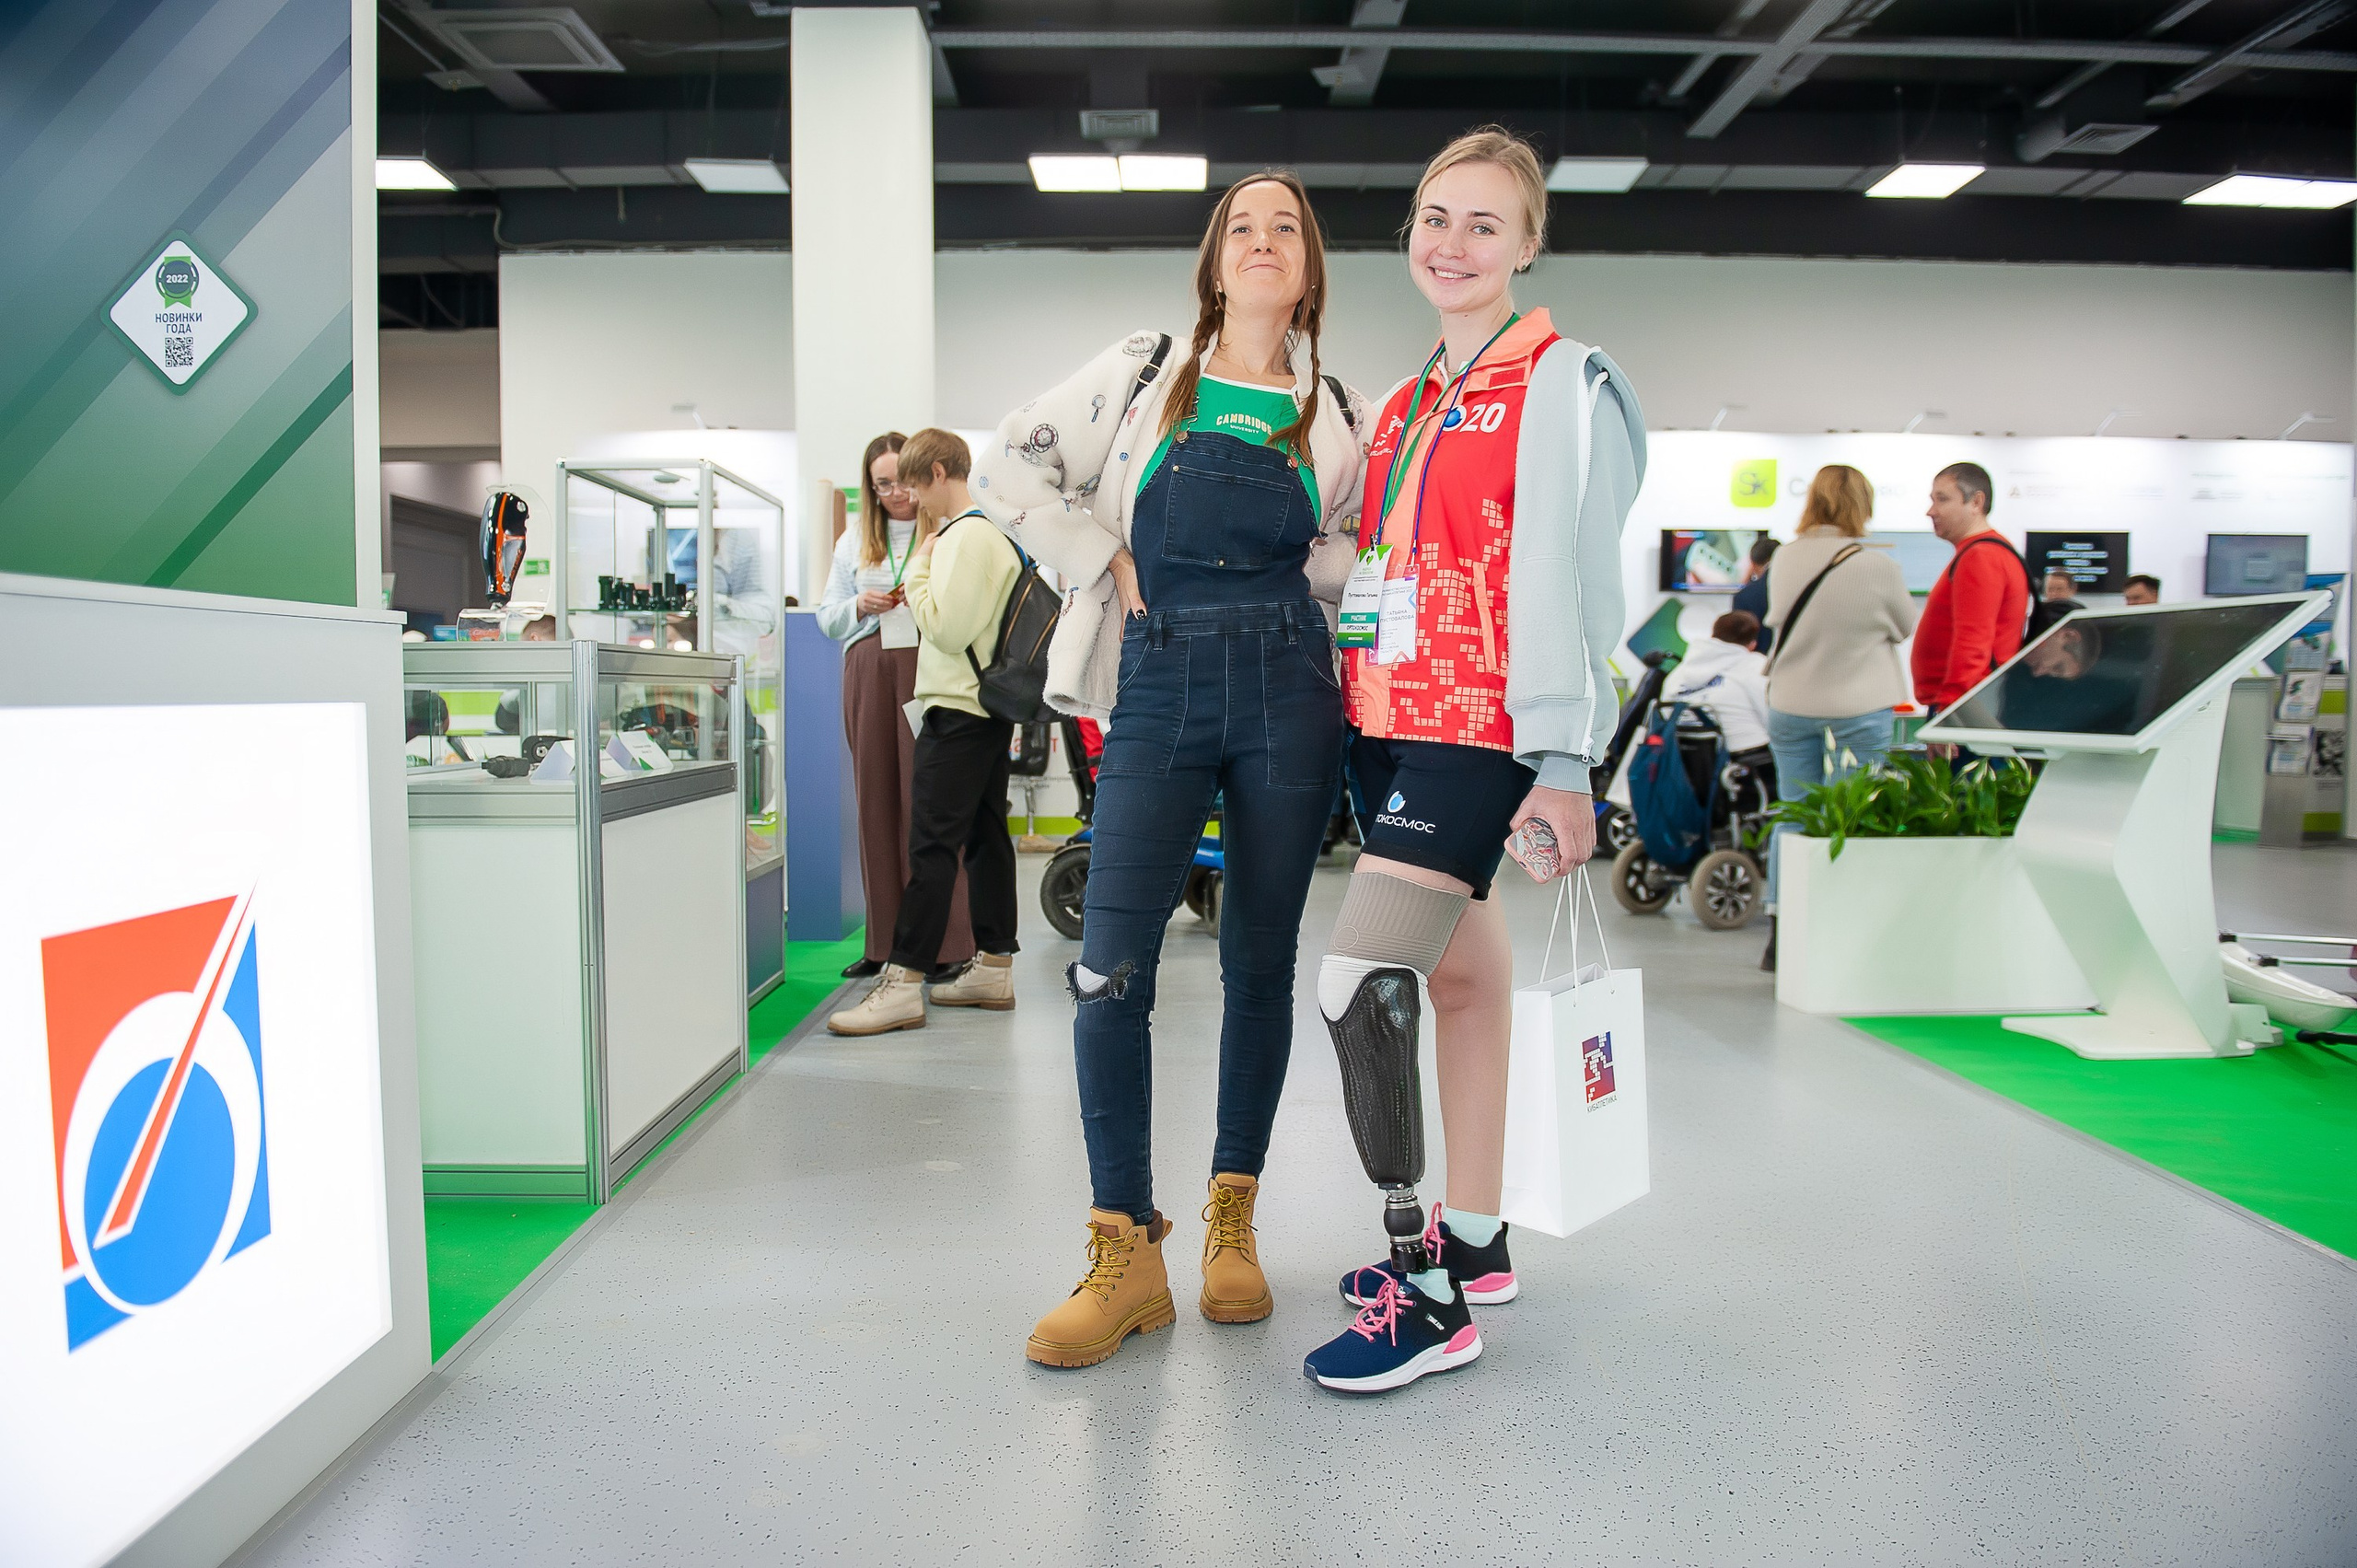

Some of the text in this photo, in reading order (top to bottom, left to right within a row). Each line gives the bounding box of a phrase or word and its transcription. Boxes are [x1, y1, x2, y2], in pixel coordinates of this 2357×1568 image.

[166, 274, 189, 284] 2022
[155, 312, 203, 323] НОВИНКИ
[166, 323, 192, 334] ГОДА
[1215, 412, 1272, 436] CAMBRIDGE
